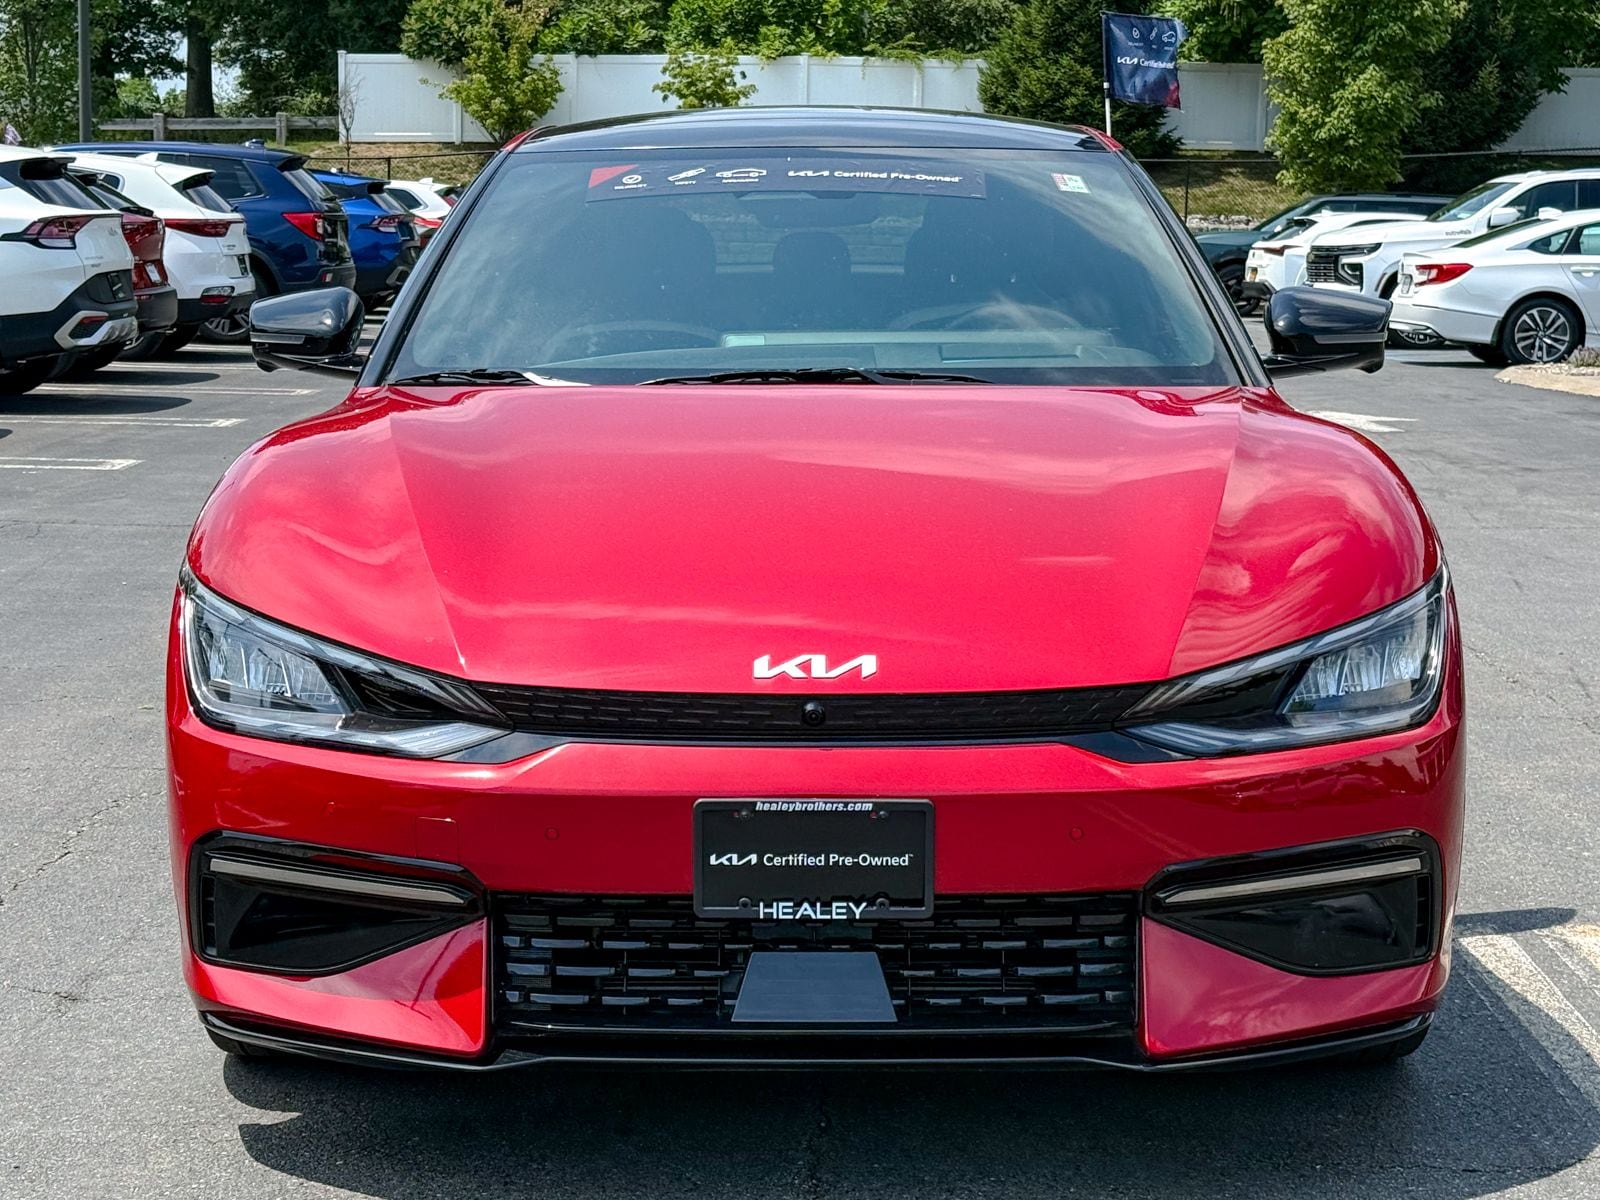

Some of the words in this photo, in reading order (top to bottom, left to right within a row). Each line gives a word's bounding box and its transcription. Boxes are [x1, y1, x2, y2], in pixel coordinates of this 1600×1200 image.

[1117, 56, 1138, 65] KIA
[834, 171, 888, 179] Certified
[890, 172, 960, 183] Pre-Owned
[753, 654, 877, 680] KIA
[755, 801, 874, 812] healeybrothers.com
[709, 853, 758, 866] KIA
[763, 853, 825, 866] Certified
[829, 853, 909, 866] Pre-Owned
[759, 901, 868, 919] HEALEY
